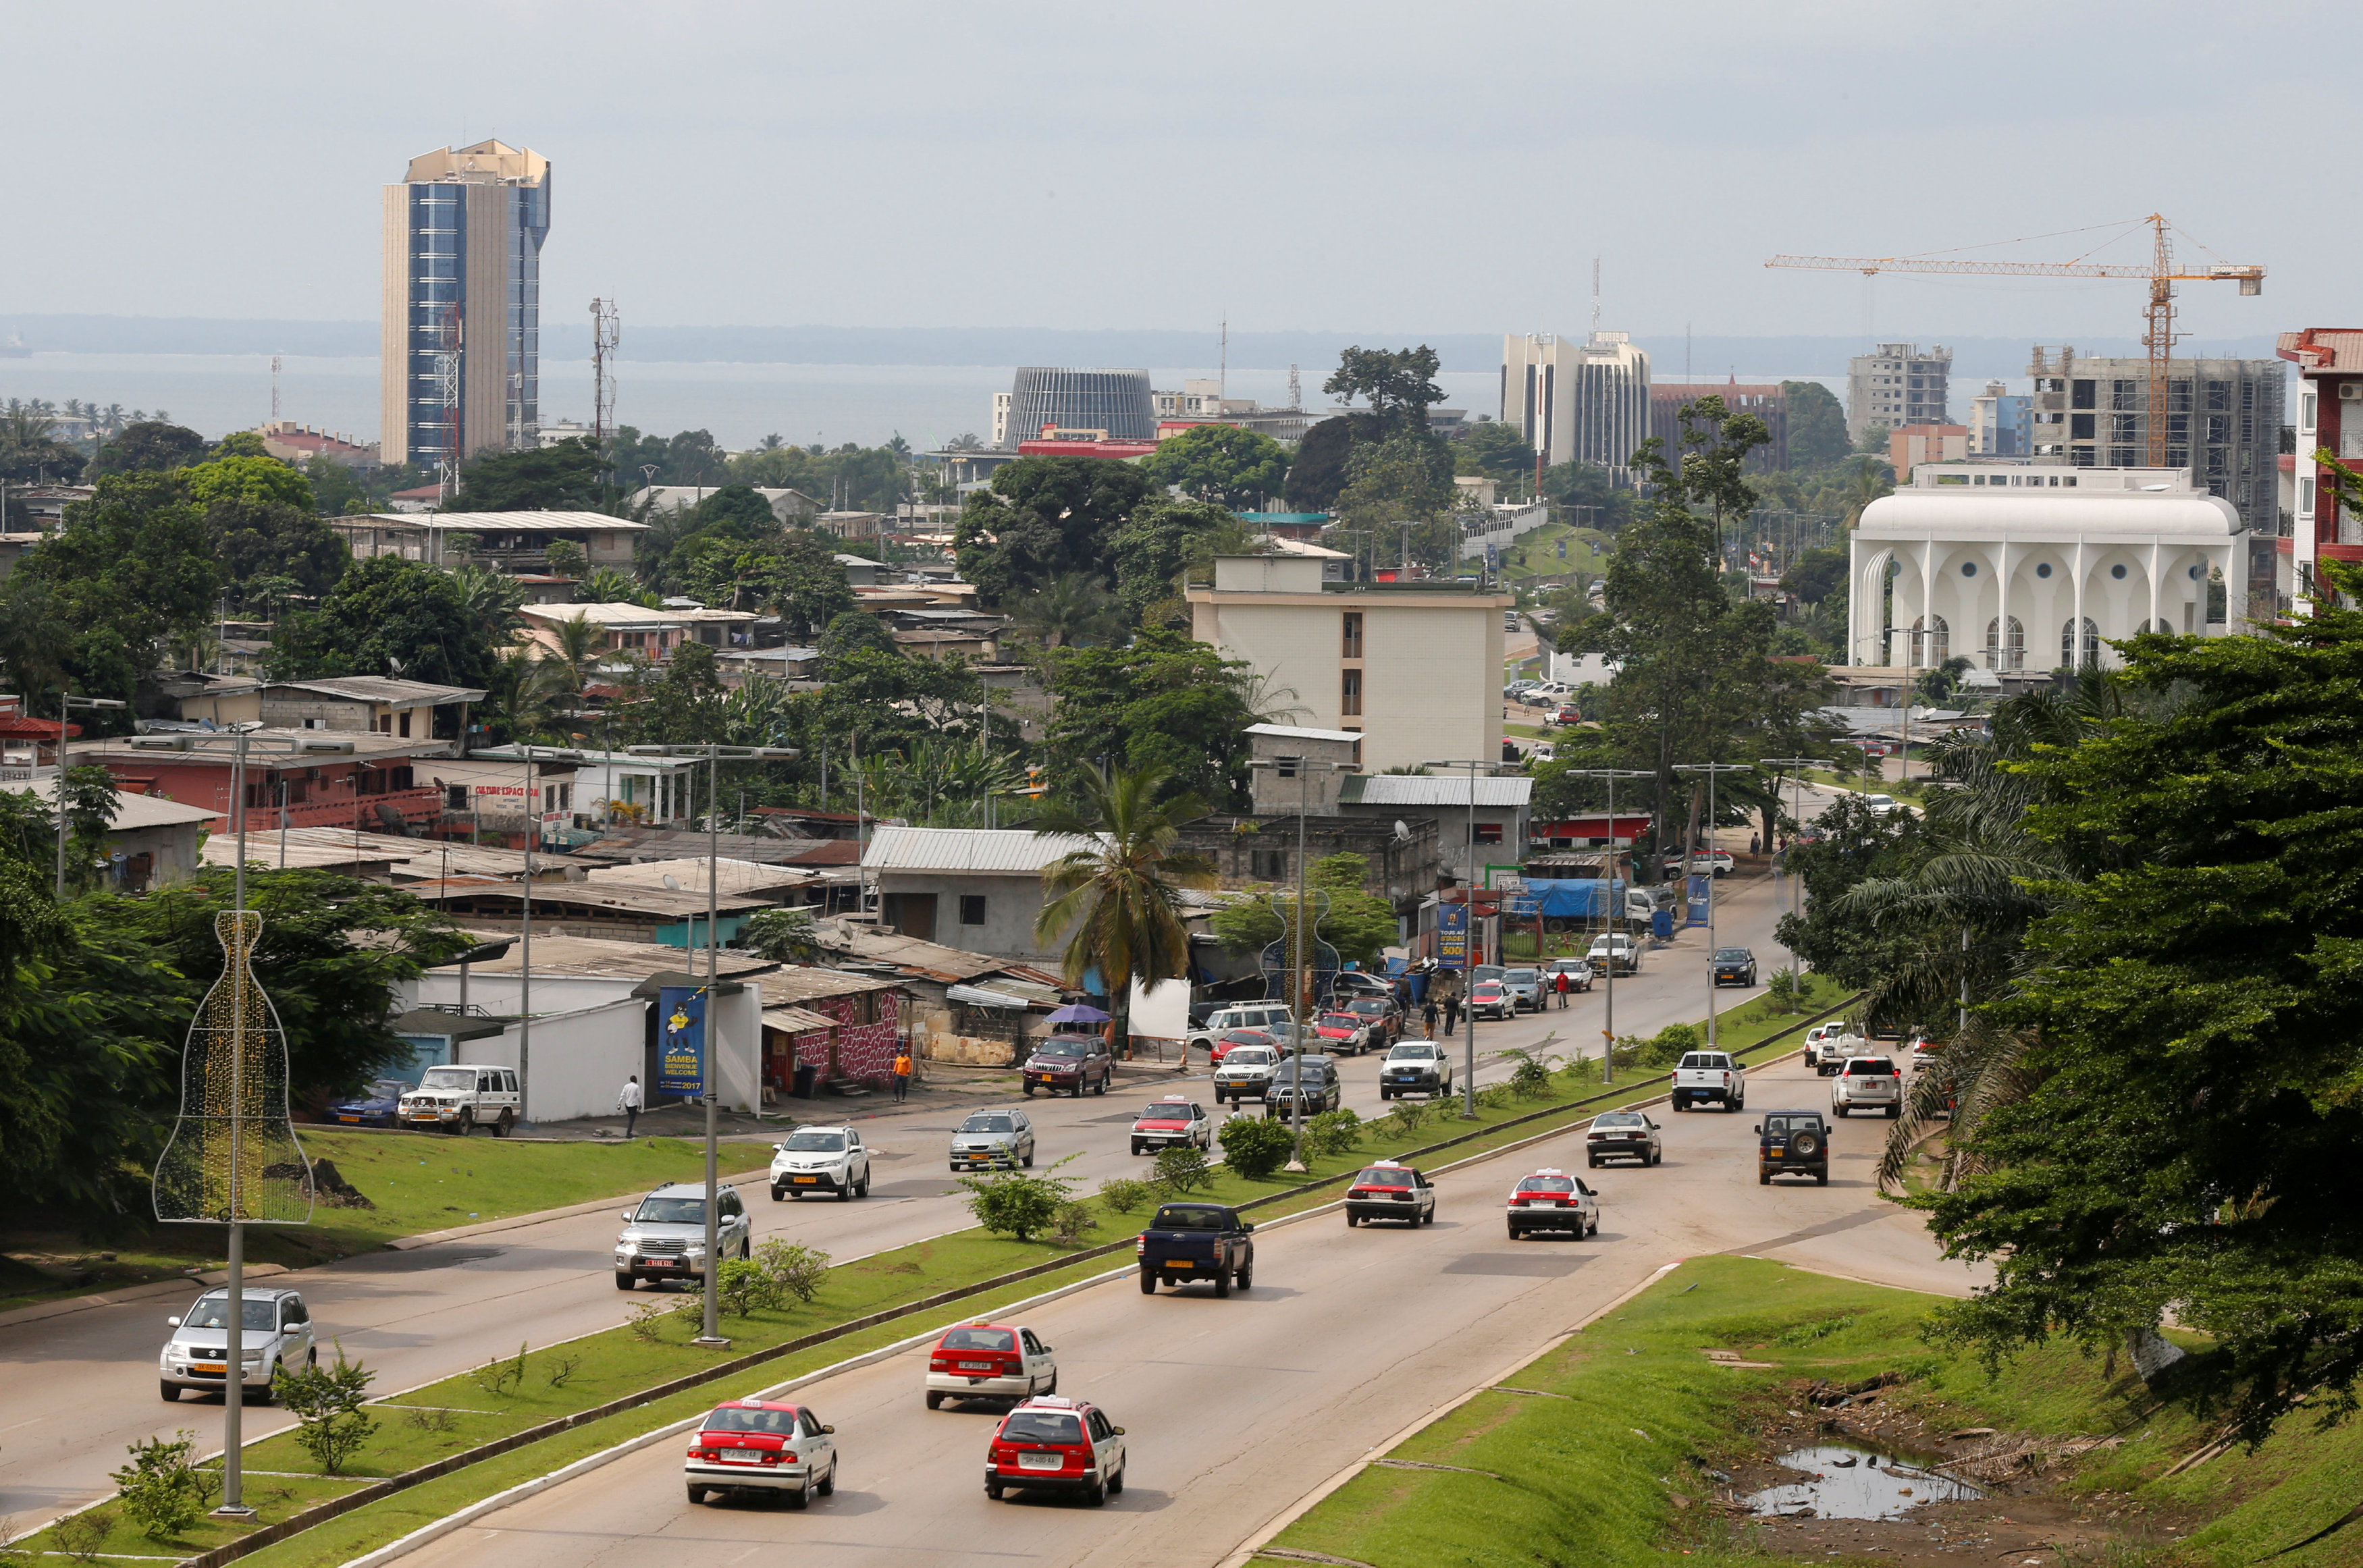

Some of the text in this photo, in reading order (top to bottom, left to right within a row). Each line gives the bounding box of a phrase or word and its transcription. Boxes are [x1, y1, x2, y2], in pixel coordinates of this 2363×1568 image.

[475, 786, 500, 795] CULTURE
[502, 787, 524, 796] ESPACE
[1442, 946, 1462, 955] 500
[665, 1055, 697, 1064] SAMBA
[682, 1082, 701, 1090] 2017
